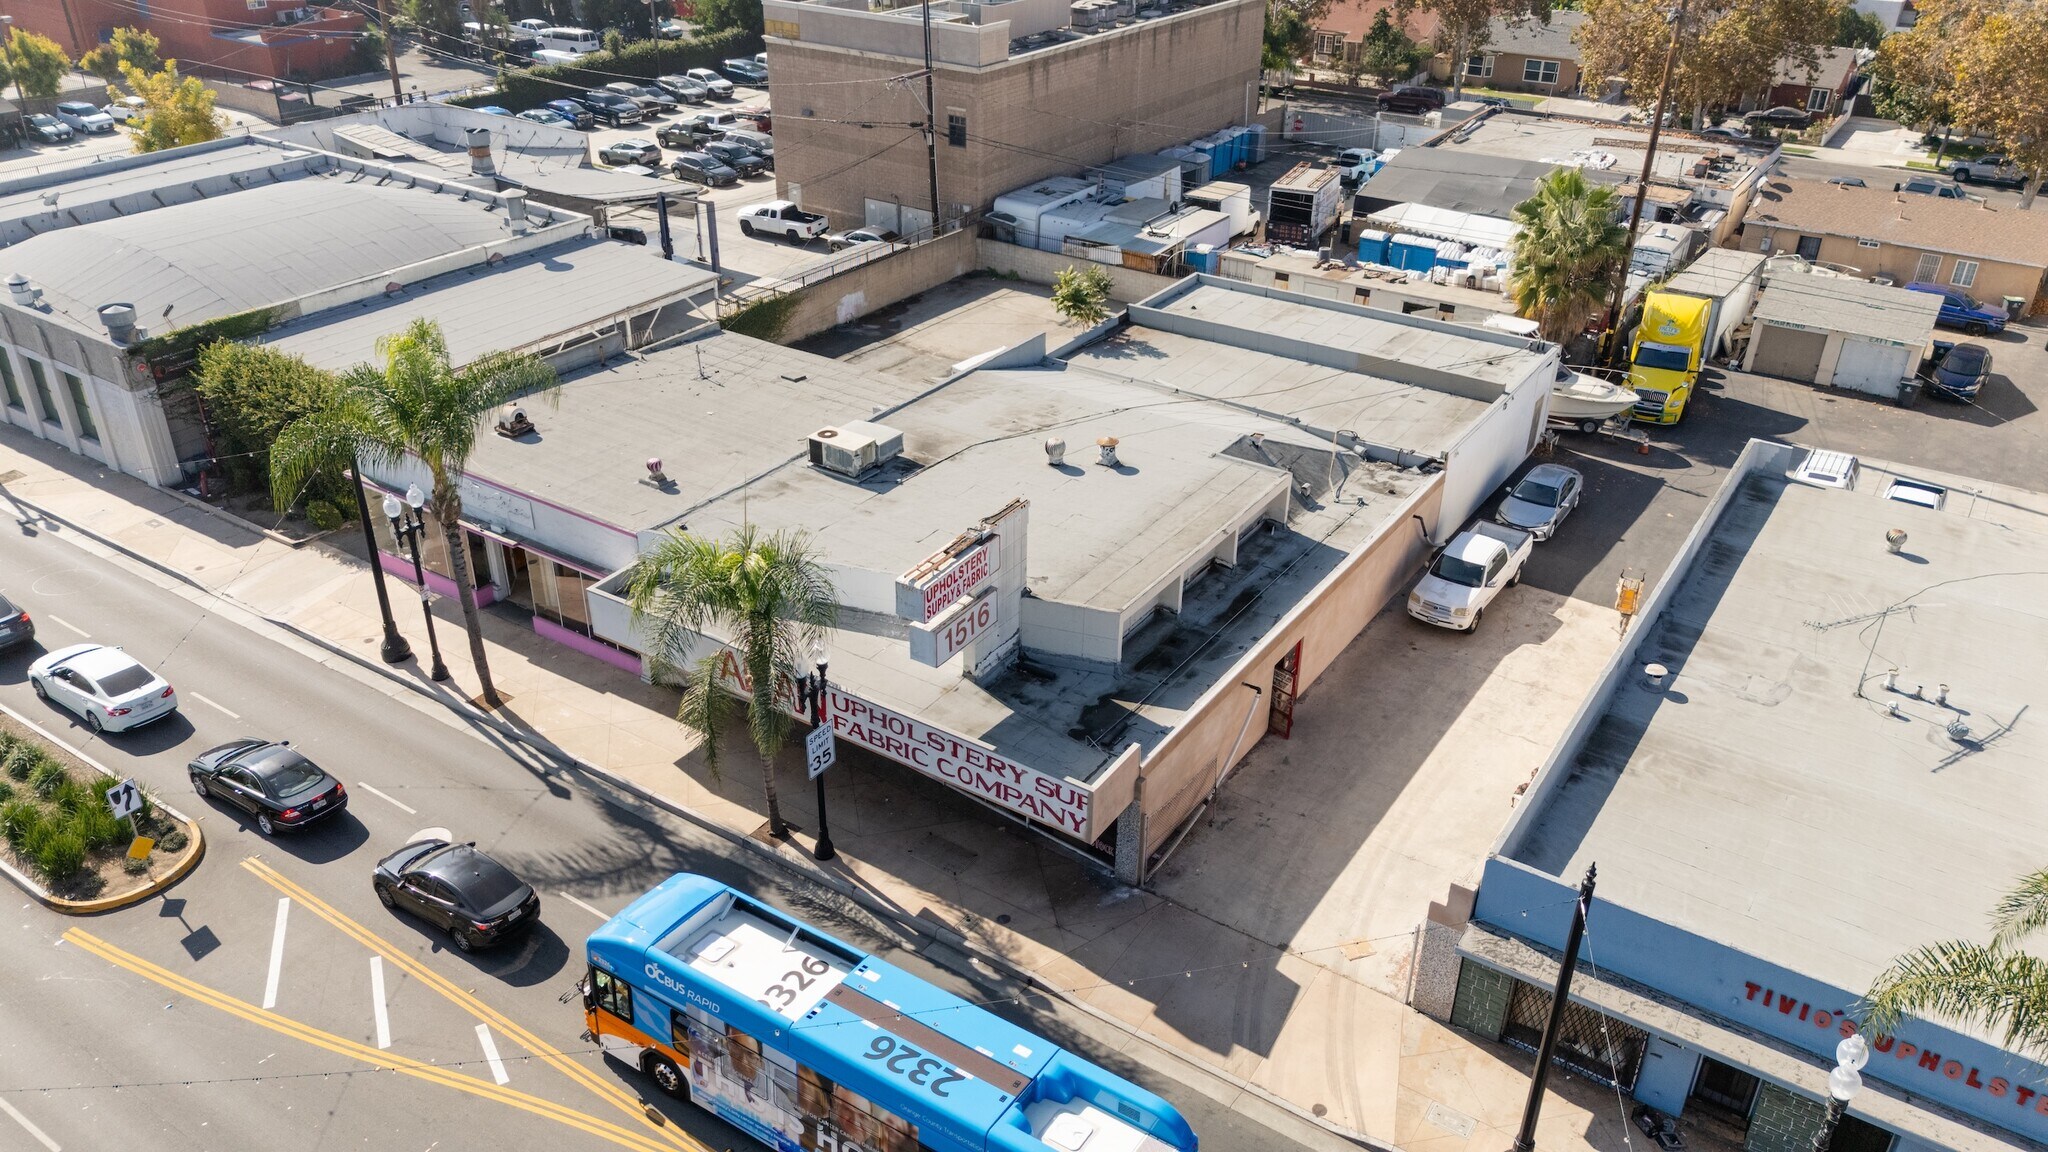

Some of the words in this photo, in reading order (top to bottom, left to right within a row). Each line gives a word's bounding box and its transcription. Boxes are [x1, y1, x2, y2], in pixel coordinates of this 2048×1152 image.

[926, 547, 988, 603] UPHOLSTERY
[926, 586, 957, 619] SUPPLY
[962, 563, 988, 591] FABRIC
[945, 602, 990, 652] 1516
[809, 725, 831, 746] SPEED
[812, 736, 829, 754] LIMIT
[813, 747, 831, 771] 35
[831, 693, 1028, 784] UPHOLSTERY
[833, 714, 928, 767] FABRIC
[937, 758, 1087, 833] COMPANY
[687, 990, 720, 1014] RAPID
[863, 1036, 966, 1097] 2326
